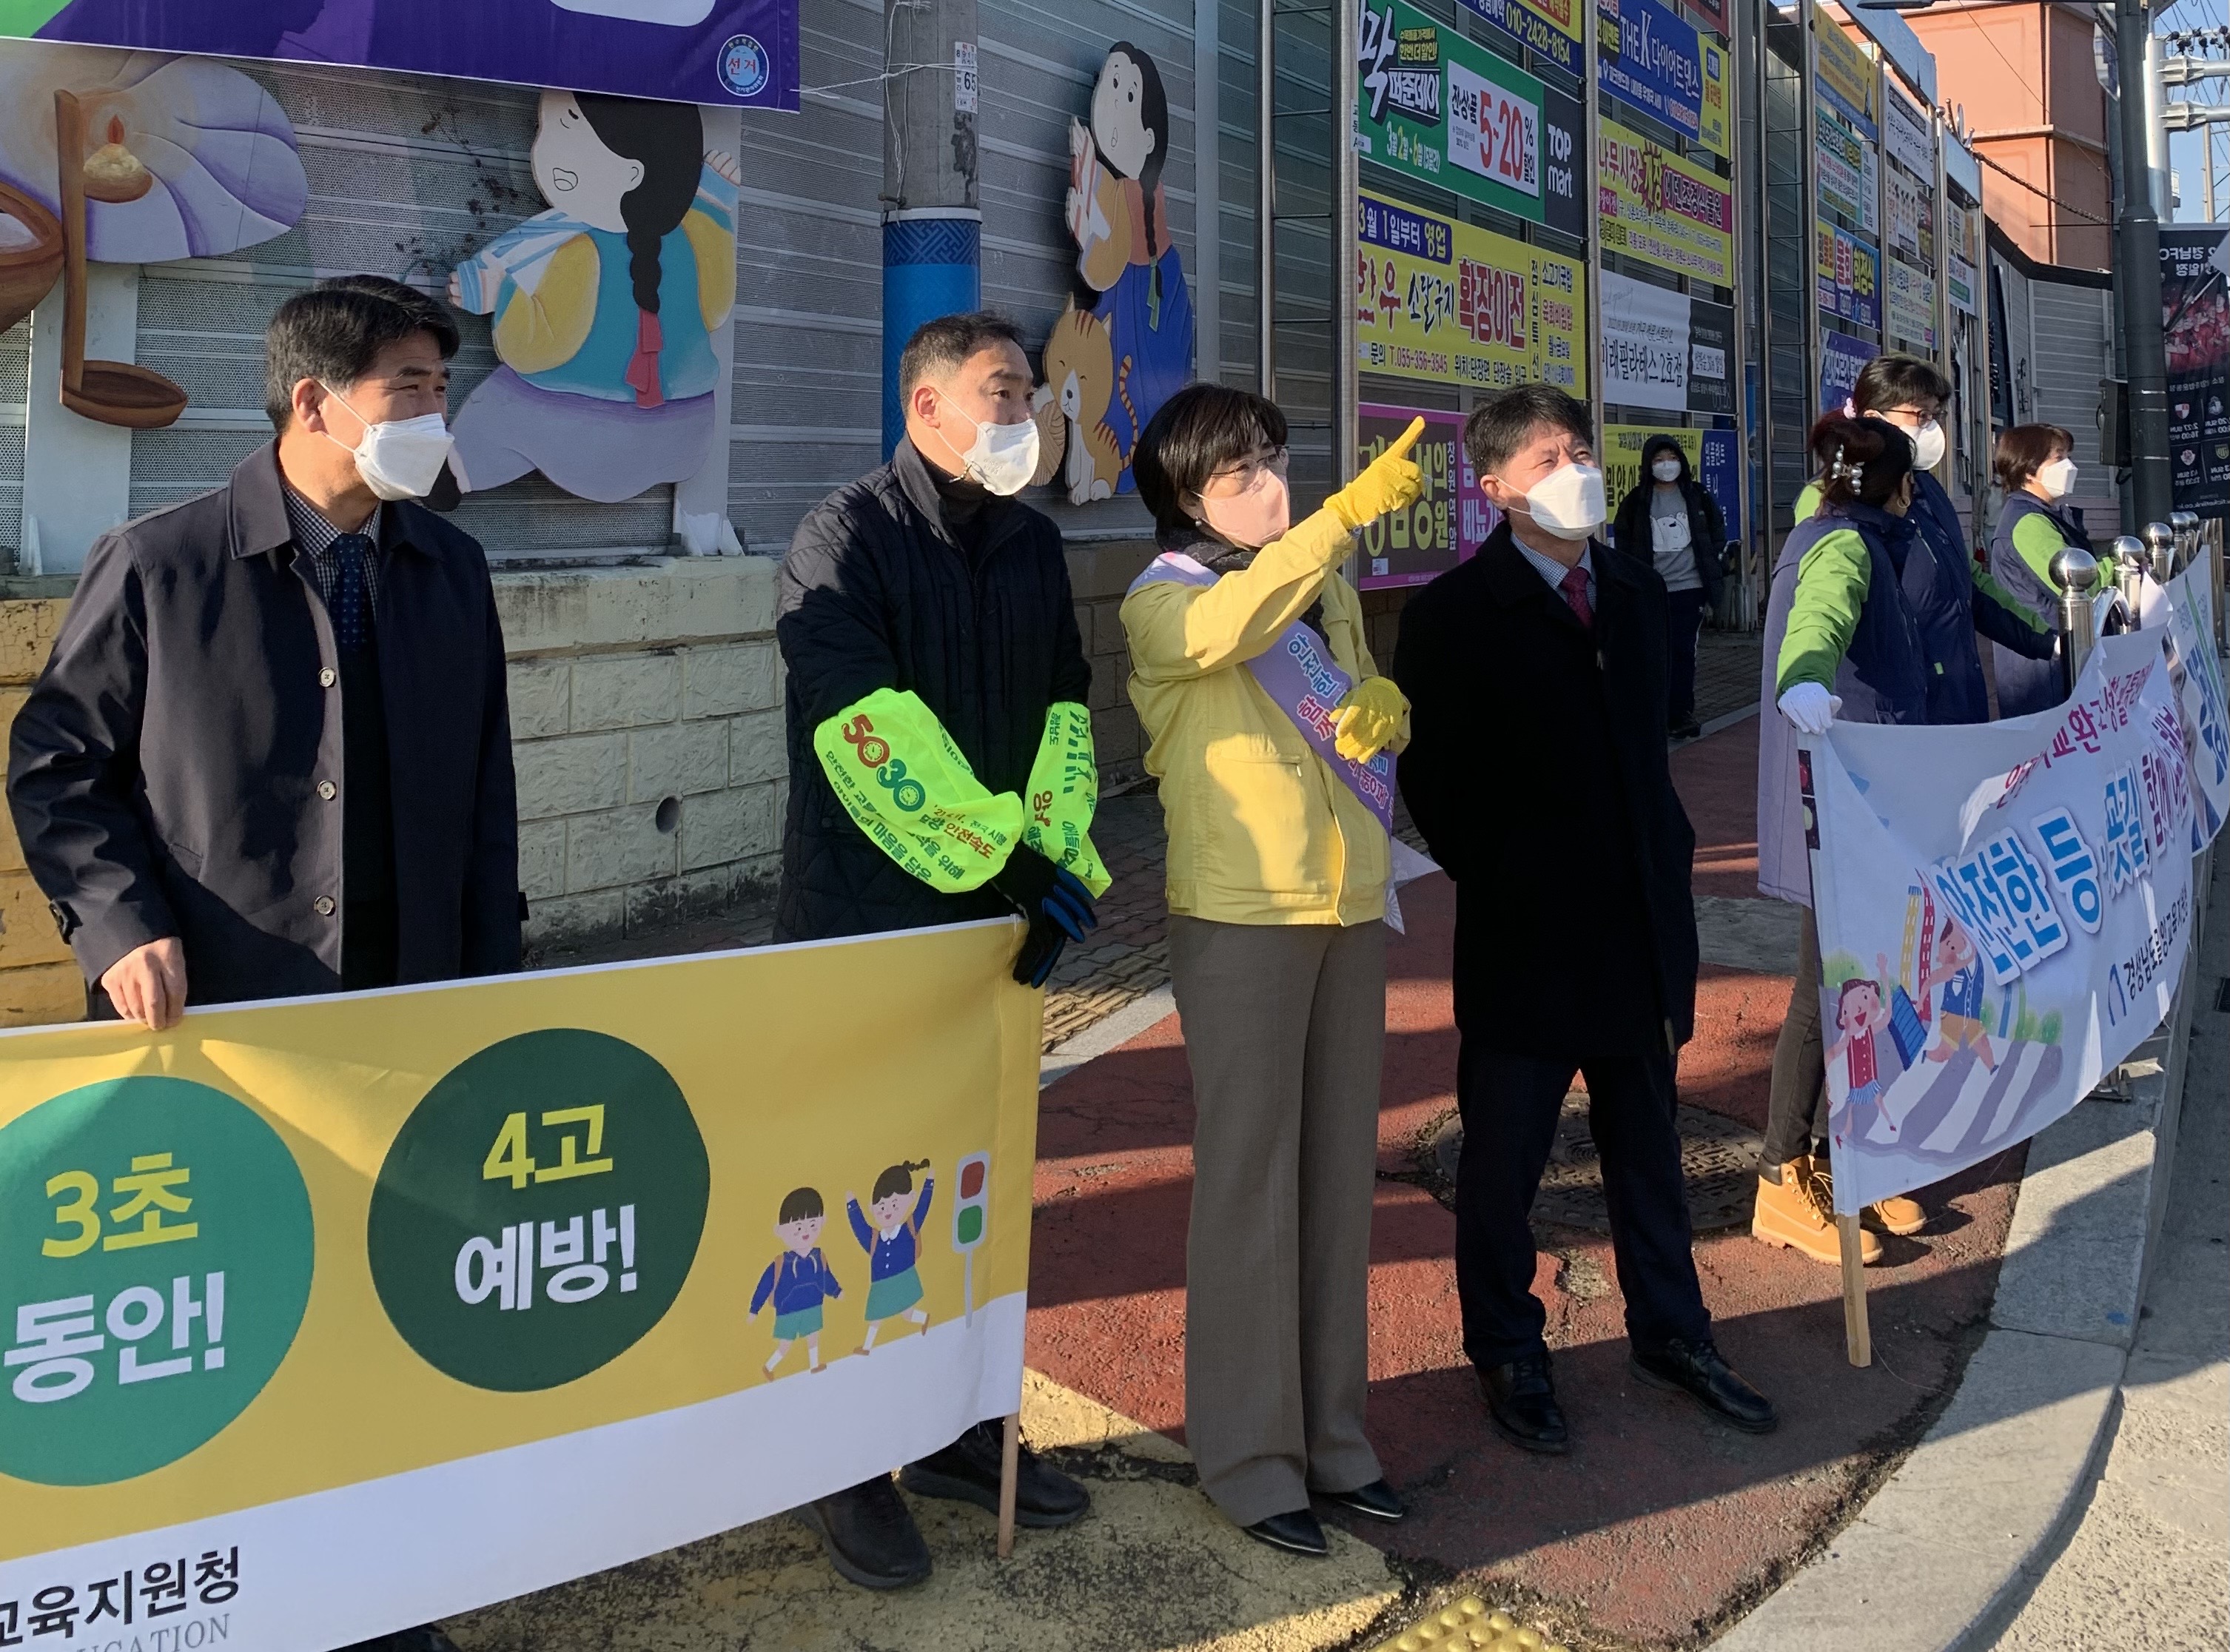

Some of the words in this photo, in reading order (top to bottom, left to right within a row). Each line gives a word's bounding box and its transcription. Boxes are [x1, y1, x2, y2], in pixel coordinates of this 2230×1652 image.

[1506, 2, 1570, 65] 010-2428-8154
[728, 58, 756, 75] 선거
[964, 72, 977, 92] 65
[1651, 38, 1699, 99] 다이어트댄스
[1452, 84, 1477, 124] 전상품
[1524, 152, 1535, 185] 할인
[1548, 123, 1572, 162] TOP
[1548, 165, 1573, 198] mart
[1359, 201, 1377, 238] 3월
[1383, 209, 1420, 251] 1일부터
[1424, 222, 1445, 258] 영업
[1358, 248, 1401, 332] 한우
[1407, 272, 1455, 335] 소달구지
[1459, 255, 1526, 352] 확장이전
[1531, 259, 1539, 379] 점심특선
[1371, 342, 1386, 366] 문의
[1288, 631, 1339, 698] 안전한
[842, 713, 926, 812] 5030
[825, 750, 856, 790] 안전한
[937, 852, 966, 881] 위해
[943, 822, 998, 859] 안전속도
[988, 829, 1007, 846] 시행
[873, 821, 909, 862] 마음을
[904, 856, 933, 882] 담은
[1935, 835, 2062, 975] 안전한
[483, 1103, 614, 1189] 4고
[41, 1151, 198, 1258] 3초
[454, 1203, 639, 1312] 예방!
[3, 1271, 226, 1404] 동안!
